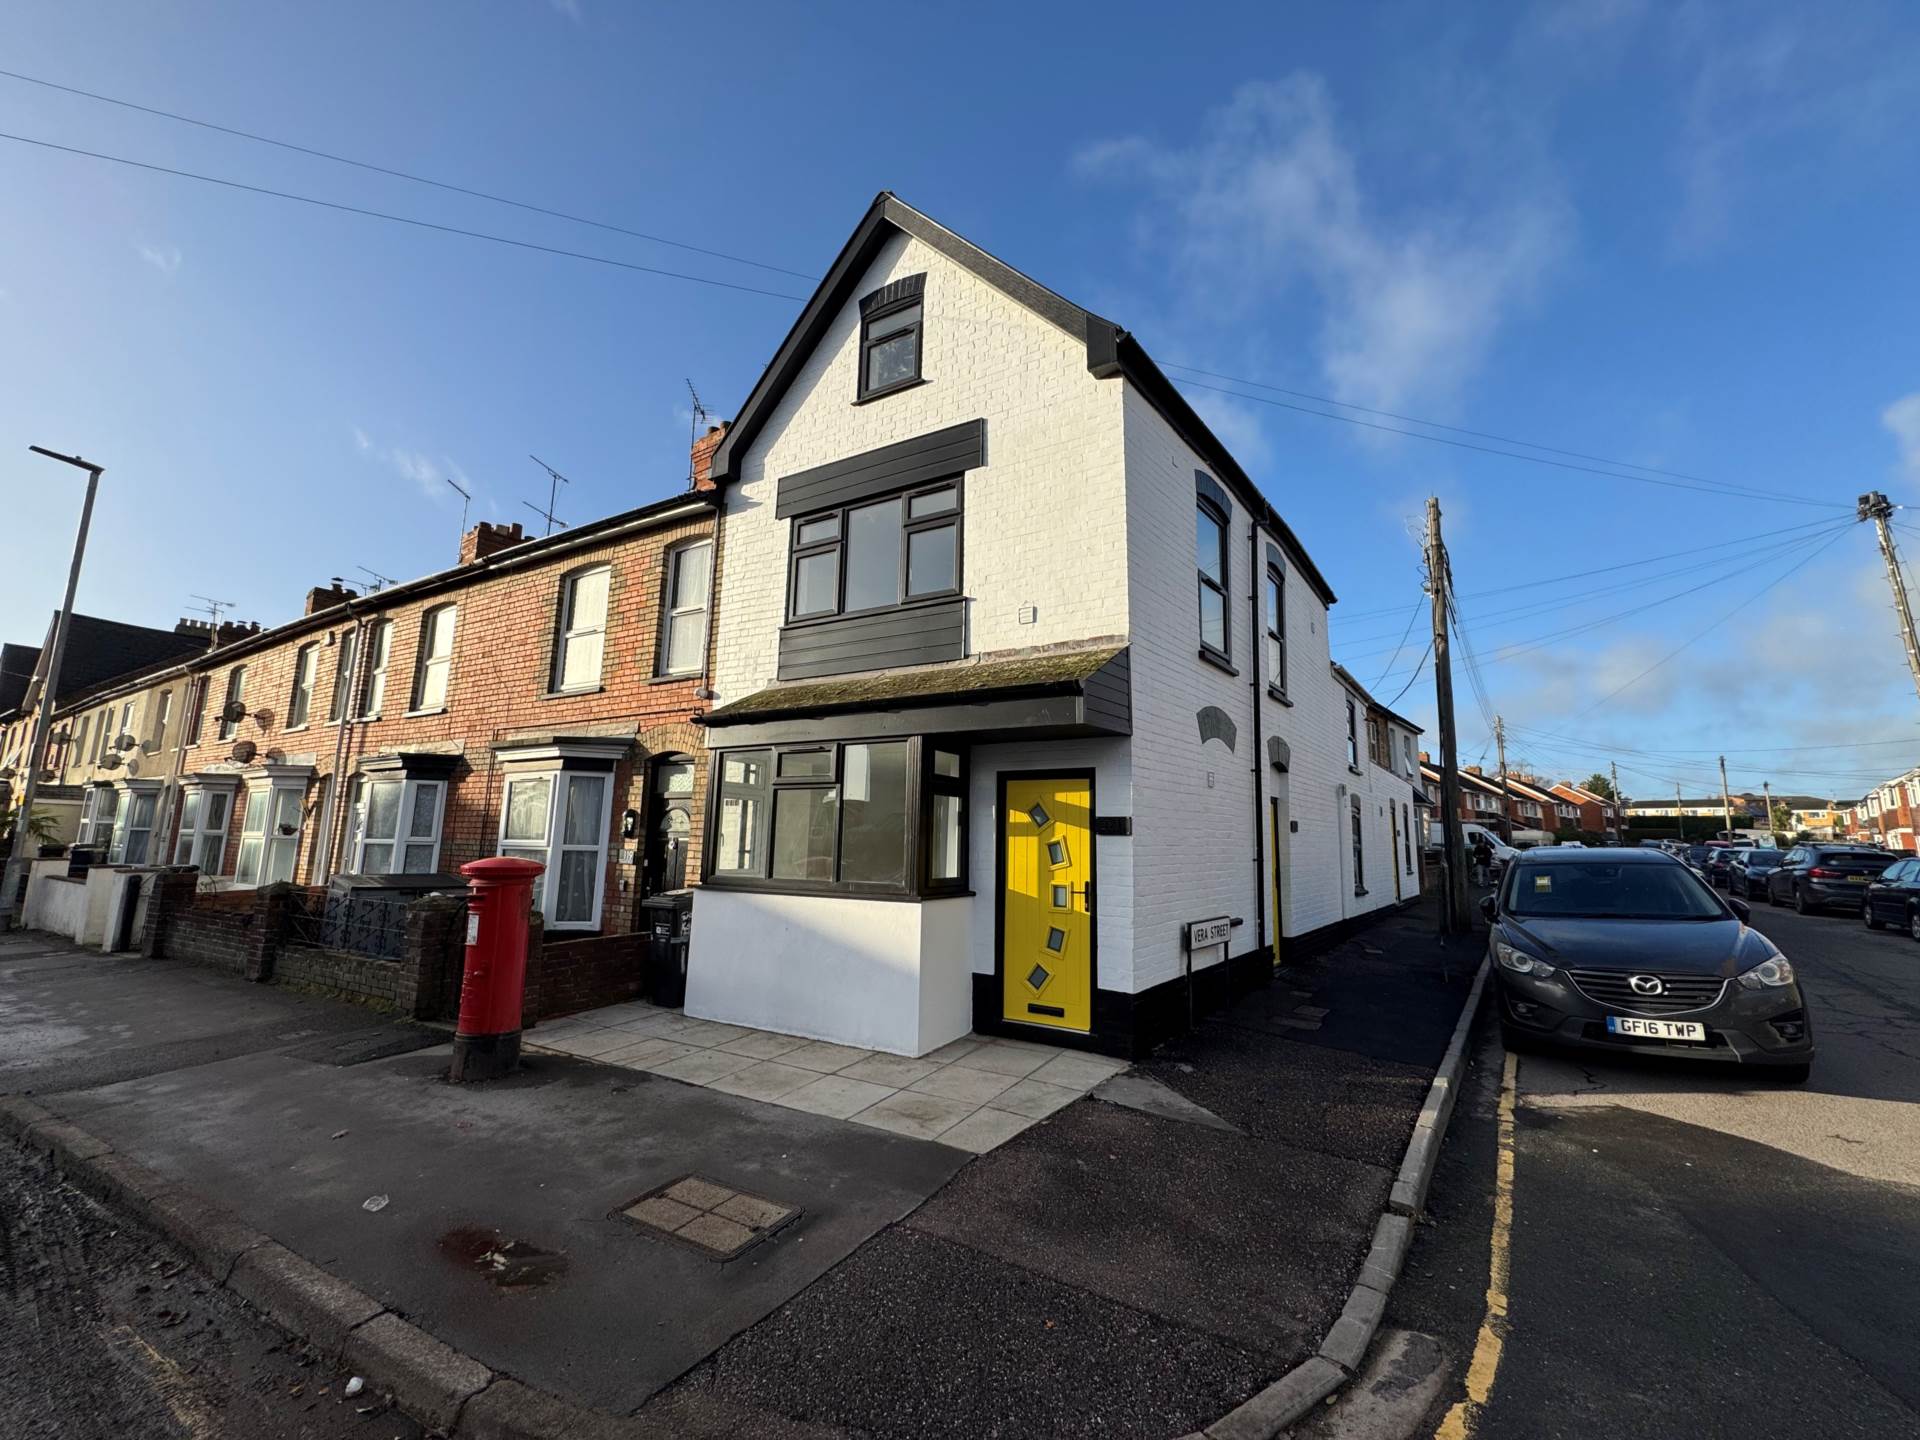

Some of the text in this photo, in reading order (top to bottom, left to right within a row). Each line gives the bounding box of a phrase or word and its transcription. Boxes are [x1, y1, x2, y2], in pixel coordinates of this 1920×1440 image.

[1193, 923, 1229, 943] VERA STREET
[1621, 1019, 1697, 1038] GF16 TWP
